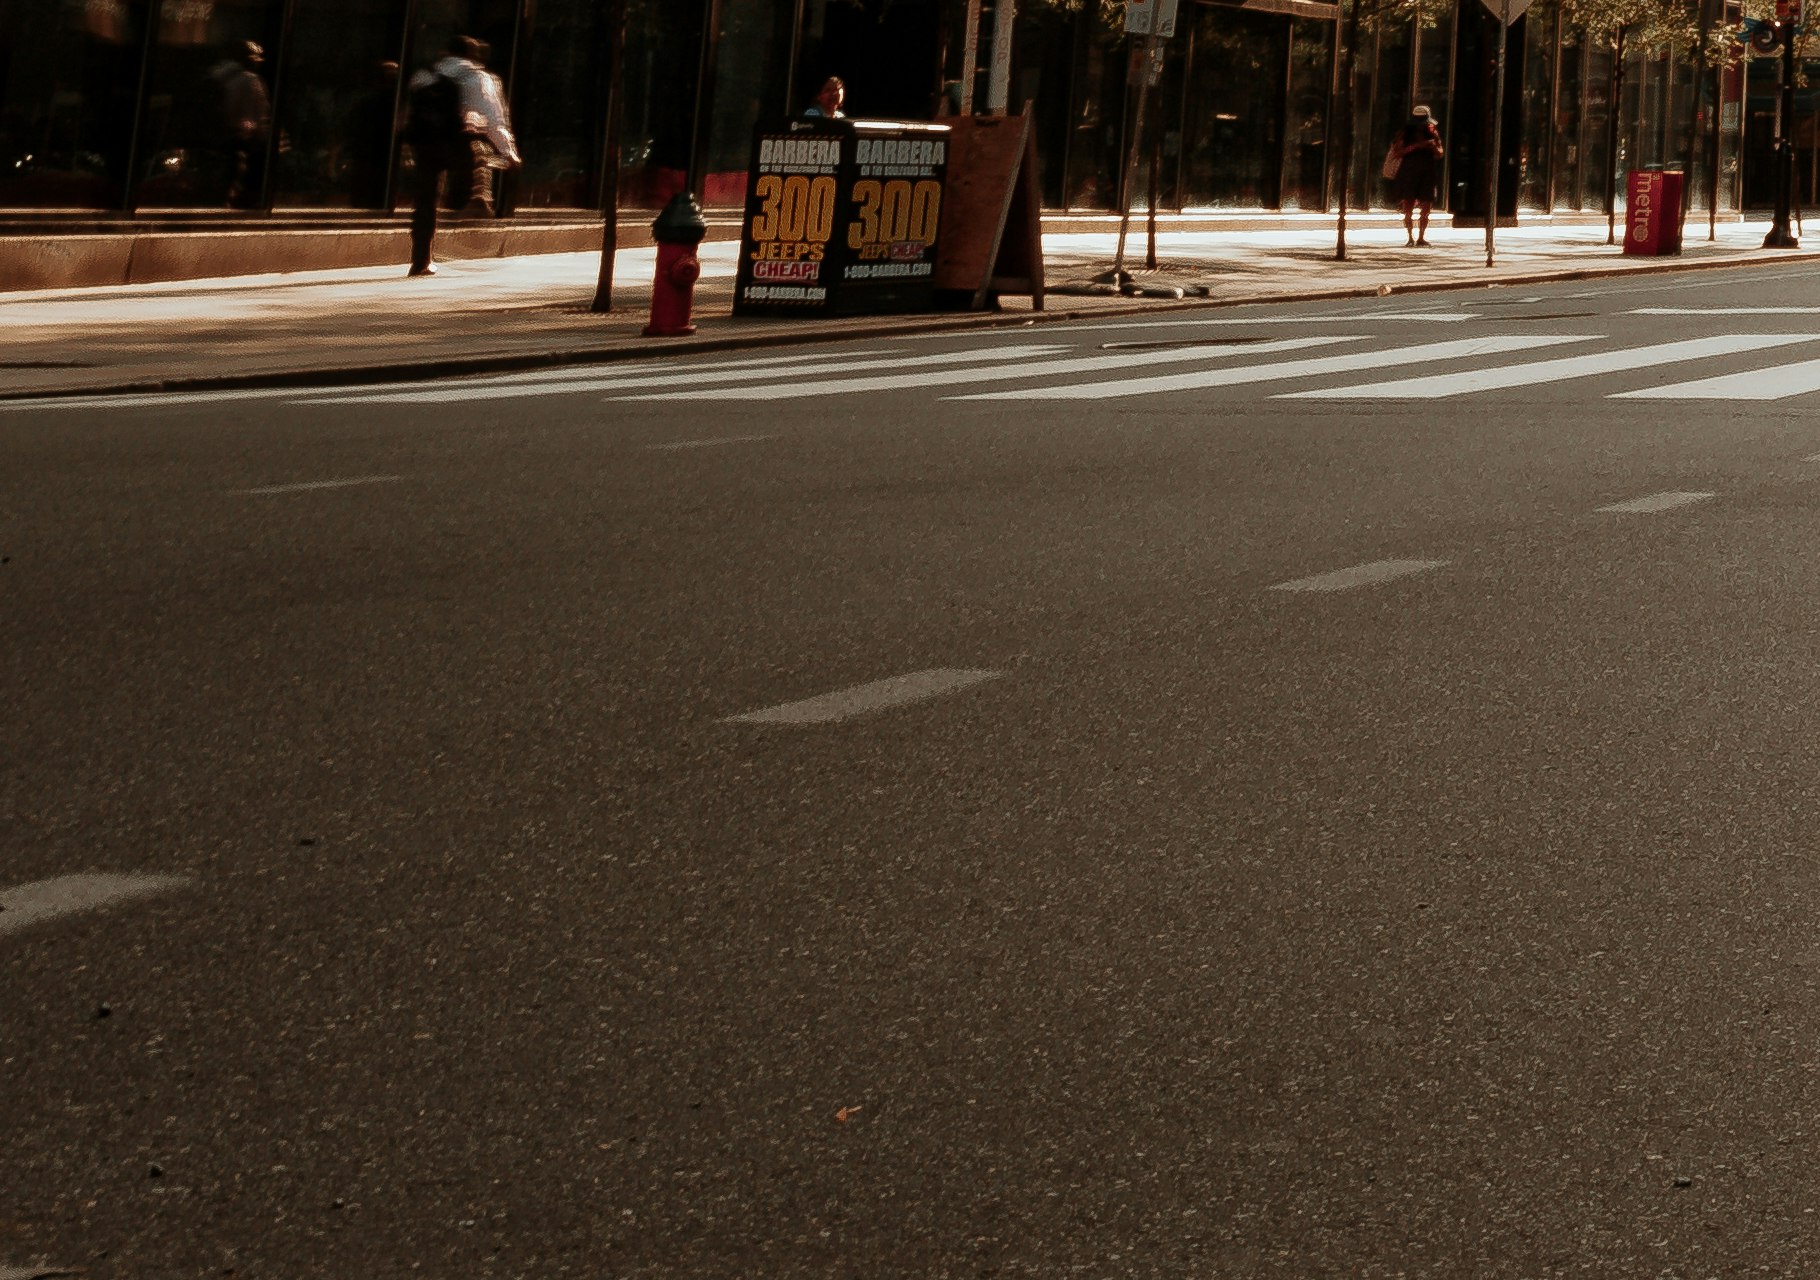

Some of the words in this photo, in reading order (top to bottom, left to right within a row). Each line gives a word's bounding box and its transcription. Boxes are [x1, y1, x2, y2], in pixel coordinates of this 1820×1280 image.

[759, 140, 841, 166] BARBERA
[855, 141, 945, 165] BARBERA
[752, 175, 837, 242] 300
[847, 180, 942, 249] 300
[751, 243, 826, 260] JEEPS
[859, 243, 889, 260] JEEPS
[754, 261, 820, 280] CHEAP!
[845, 263, 932, 279] 1-800-BARBERA.COM
